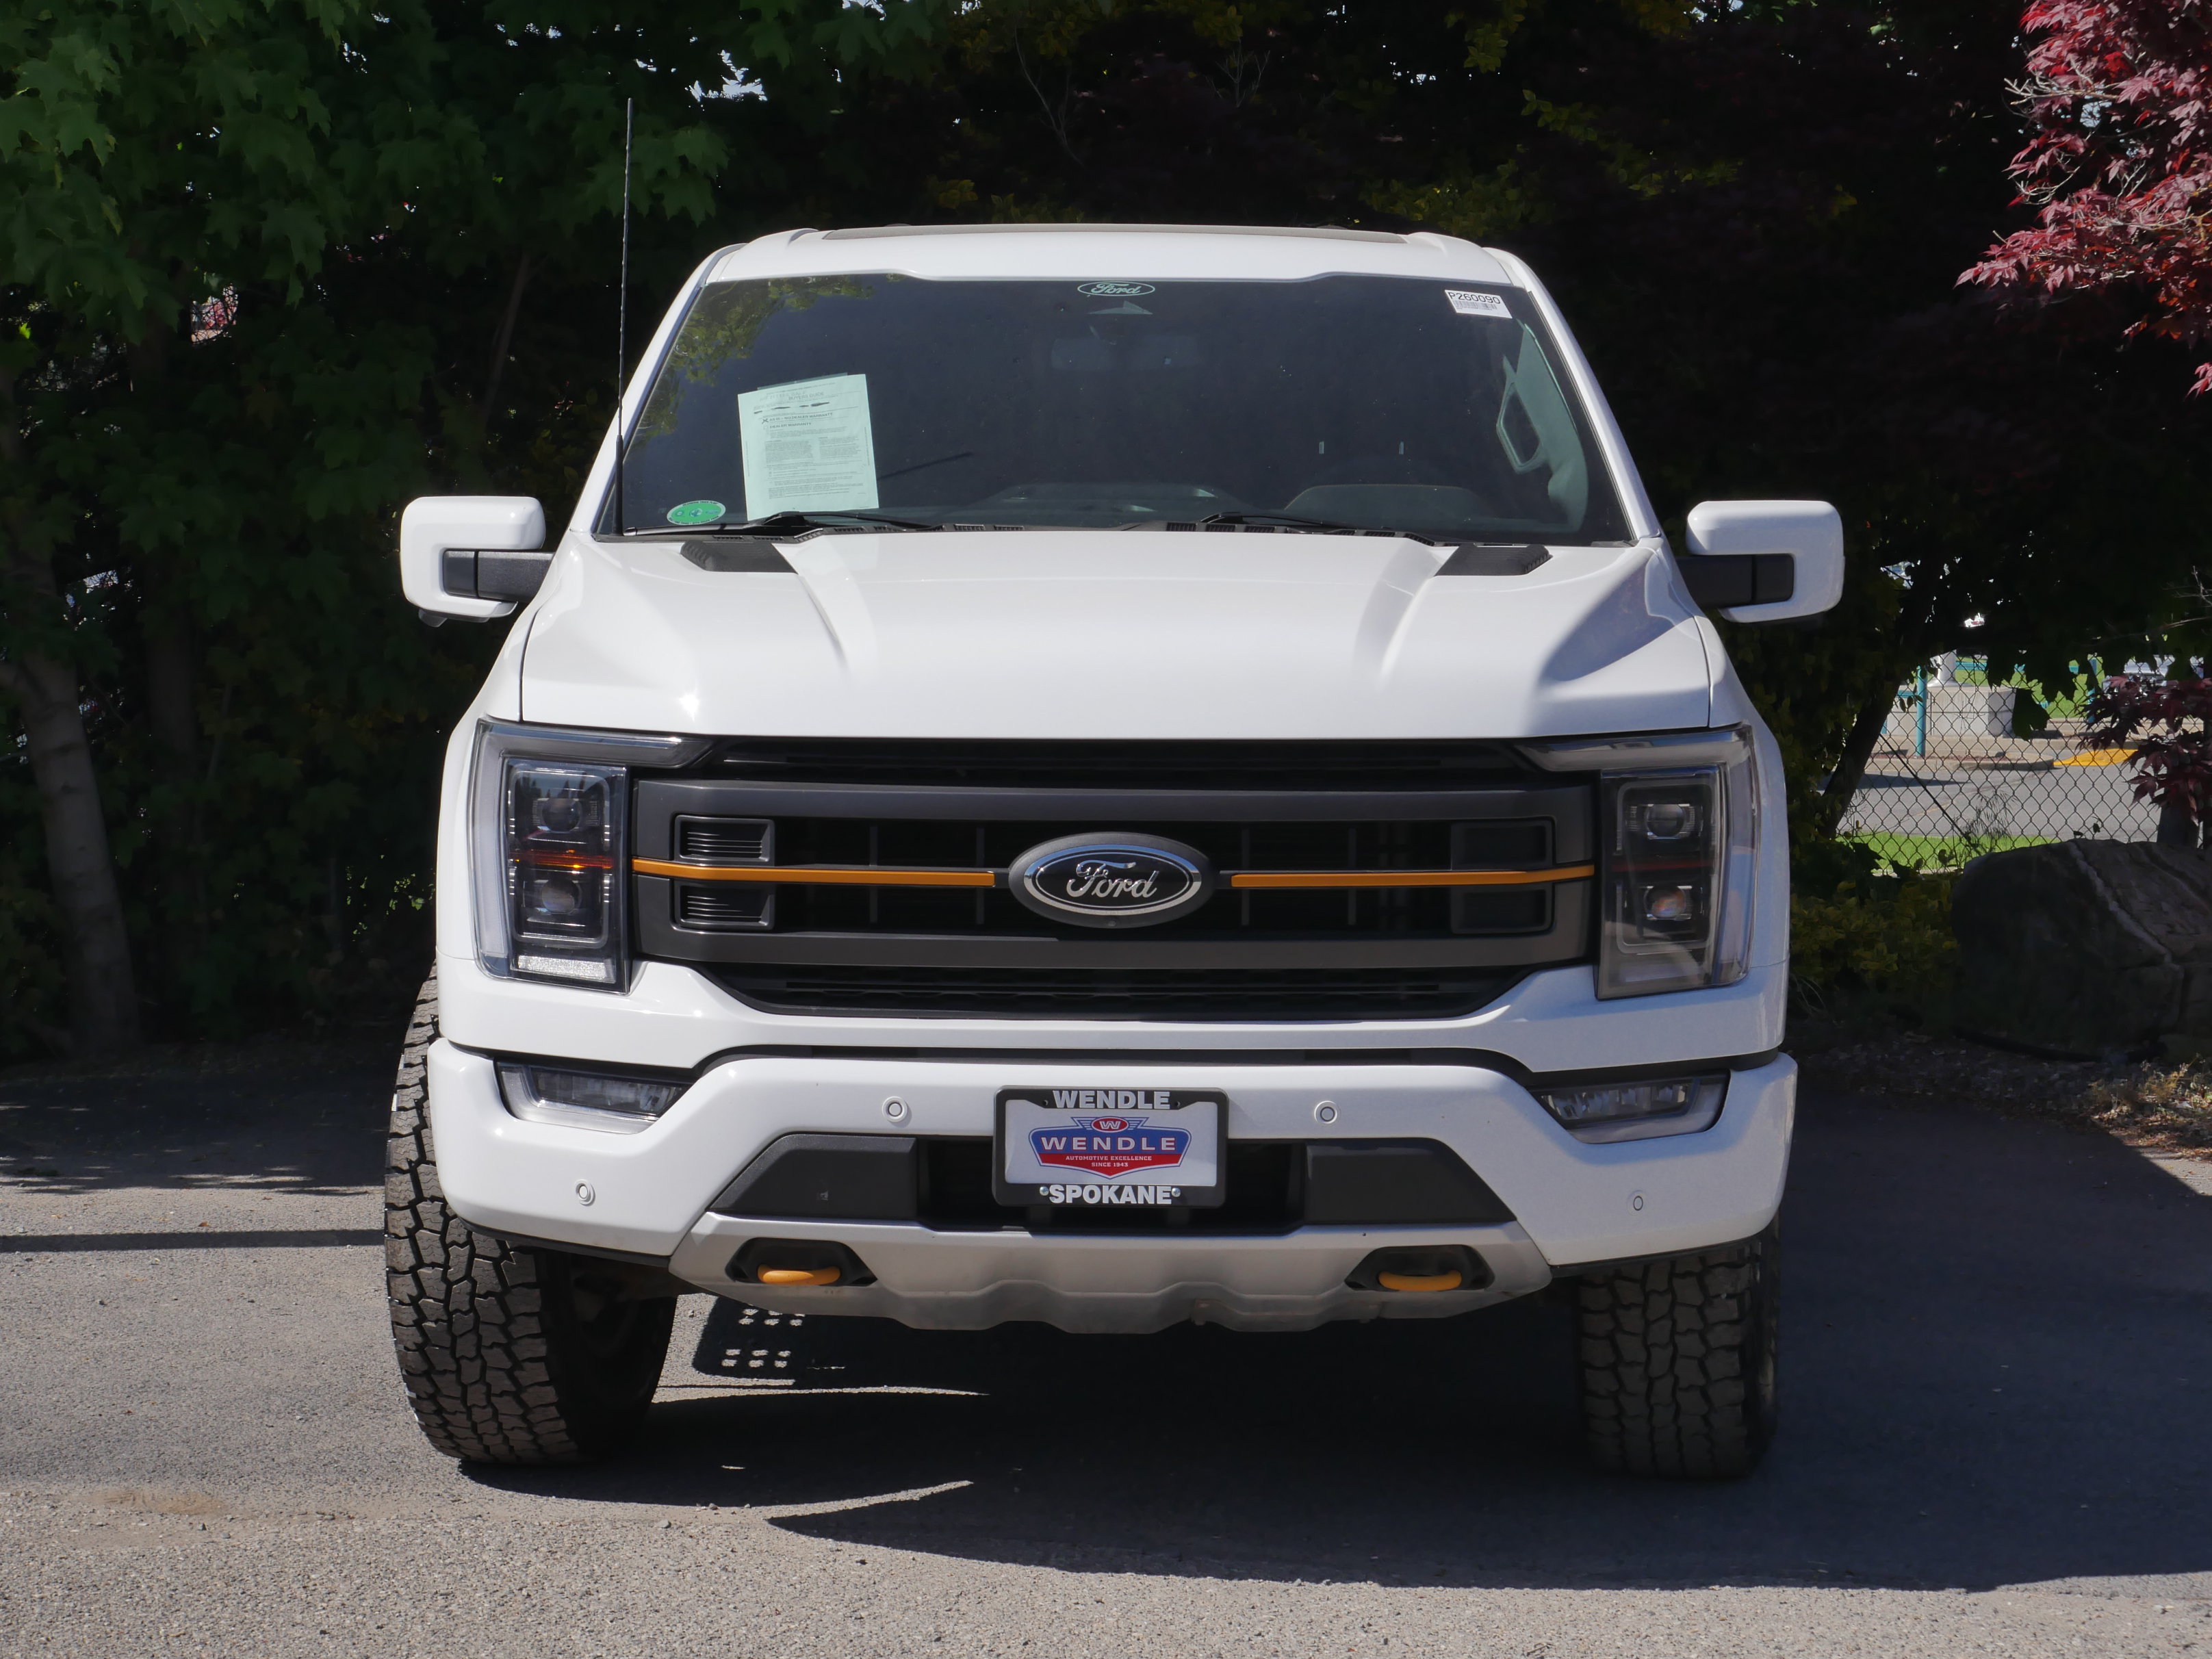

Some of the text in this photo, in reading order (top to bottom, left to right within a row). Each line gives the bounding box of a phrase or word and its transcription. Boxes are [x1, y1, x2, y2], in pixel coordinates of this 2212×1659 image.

[1091, 283, 1142, 294] Ford
[1448, 292, 1500, 304] P260090
[1066, 860, 1159, 898] Ford
[1053, 1090, 1170, 1109] WENDLE
[1099, 1120, 1121, 1130] W
[1041, 1137, 1176, 1150] WENDLE
[1049, 1185, 1172, 1205] SPOKANE
